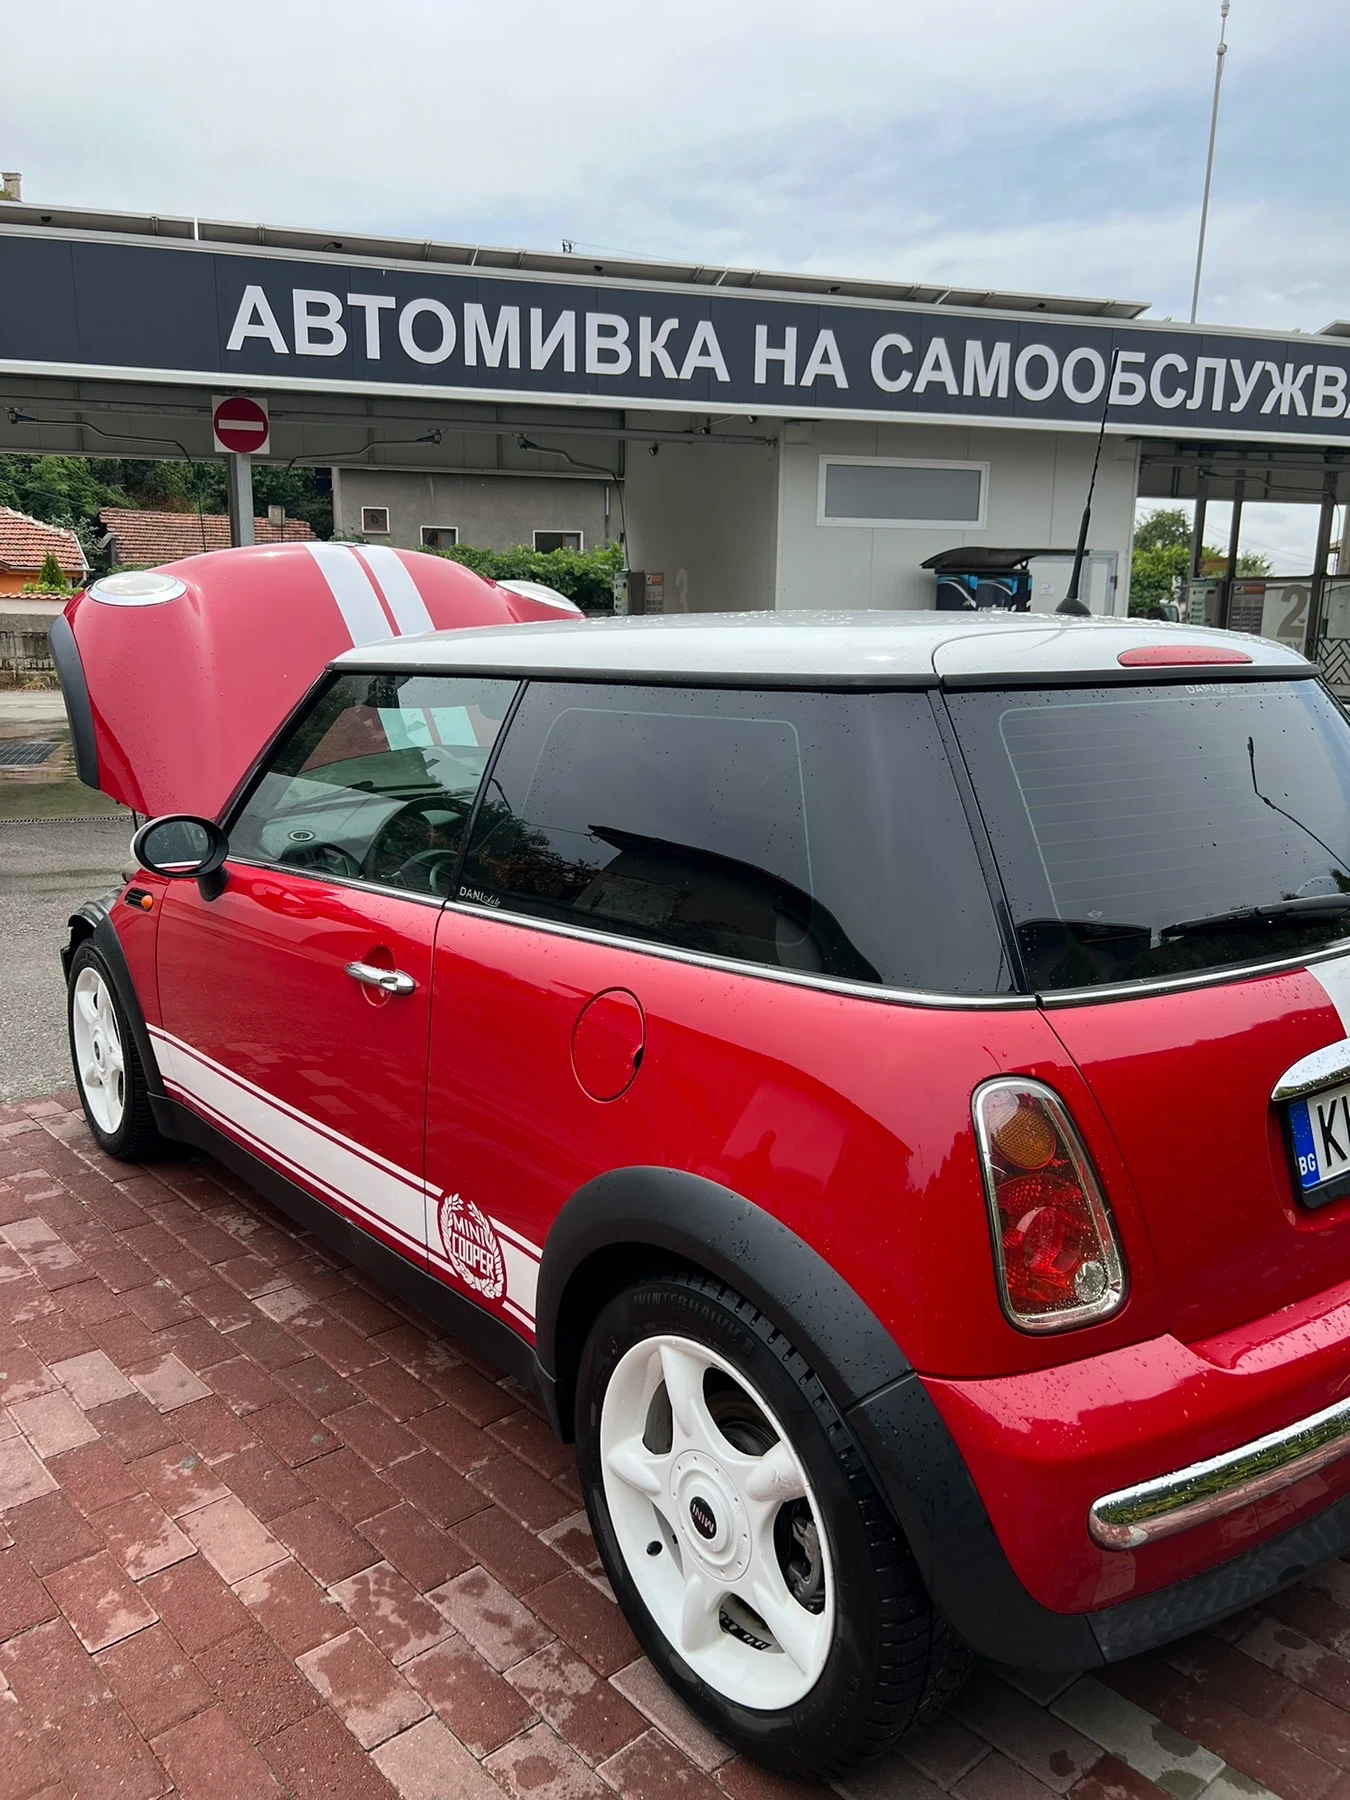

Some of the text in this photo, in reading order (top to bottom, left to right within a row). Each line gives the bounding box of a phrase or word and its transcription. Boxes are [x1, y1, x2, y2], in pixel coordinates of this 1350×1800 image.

[226, 284, 1350, 419] АВТОМИВКА НА САМООБСЛУЖВ
[1276, 583, 1307, 638] 2
[459, 886, 484, 901] DANI
[1298, 1153, 1316, 1176] BG
[452, 1211, 486, 1247] MINI
[452, 1233, 495, 1280] COOPER
[692, 1503, 715, 1534] MINI
